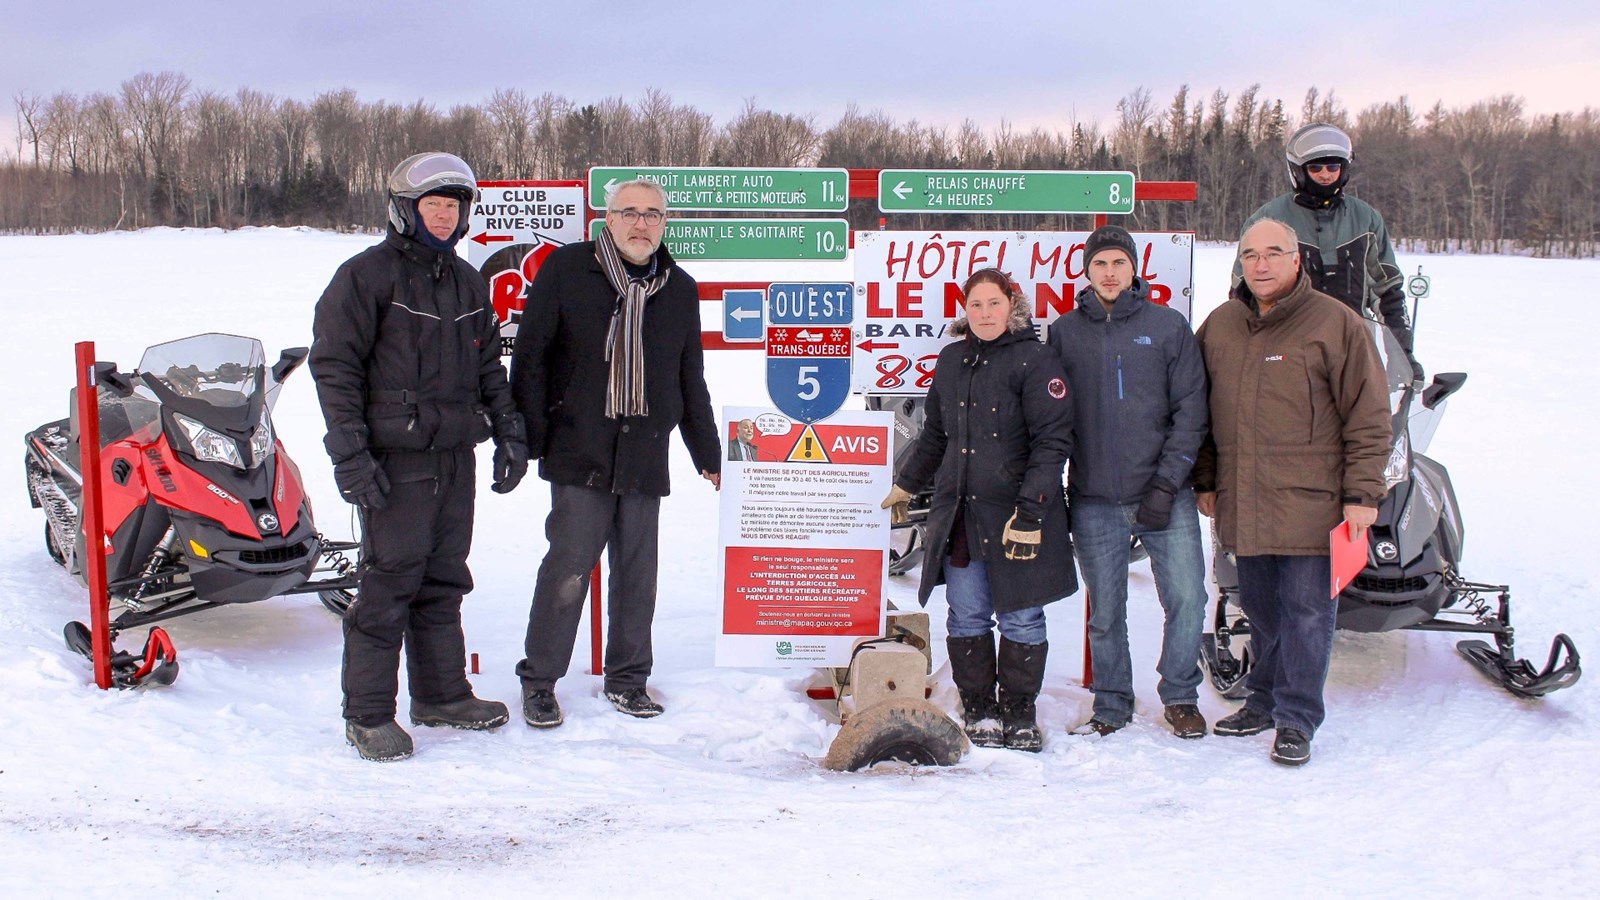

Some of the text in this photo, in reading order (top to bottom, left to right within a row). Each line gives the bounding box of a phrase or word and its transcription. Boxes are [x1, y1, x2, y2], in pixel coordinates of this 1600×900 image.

[684, 174, 736, 187] LAMBERT
[742, 175, 773, 188] AUTO
[928, 174, 1026, 190] RELAIS CHAUFFÉ
[502, 190, 547, 202] CLUB
[666, 191, 806, 204] NEIGE VTT & PETITS MOTEURS
[822, 180, 834, 202] 11
[1109, 182, 1120, 204] 8
[928, 194, 993, 206] 24 HEURES
[1122, 197, 1130, 205] KM
[474, 204, 576, 216] AUTO-NEIGE
[486, 218, 564, 230] RIVE-SUD
[664, 226, 805, 238] TAURANT LE SAGITTAIRE
[666, 242, 705, 254] EURES
[816, 230, 834, 253] 10
[886, 233, 1158, 282] HÔTEL MOL
[776, 291, 846, 318] OUEST
[866, 282, 923, 318] LE
[771, 342, 848, 355] TRANS-QUÉBEC
[797, 366, 820, 401] 5
[831, 436, 880, 454] AVIS
[756, 619, 853, 627] ministre@mapaq.gouv.qc.ca
